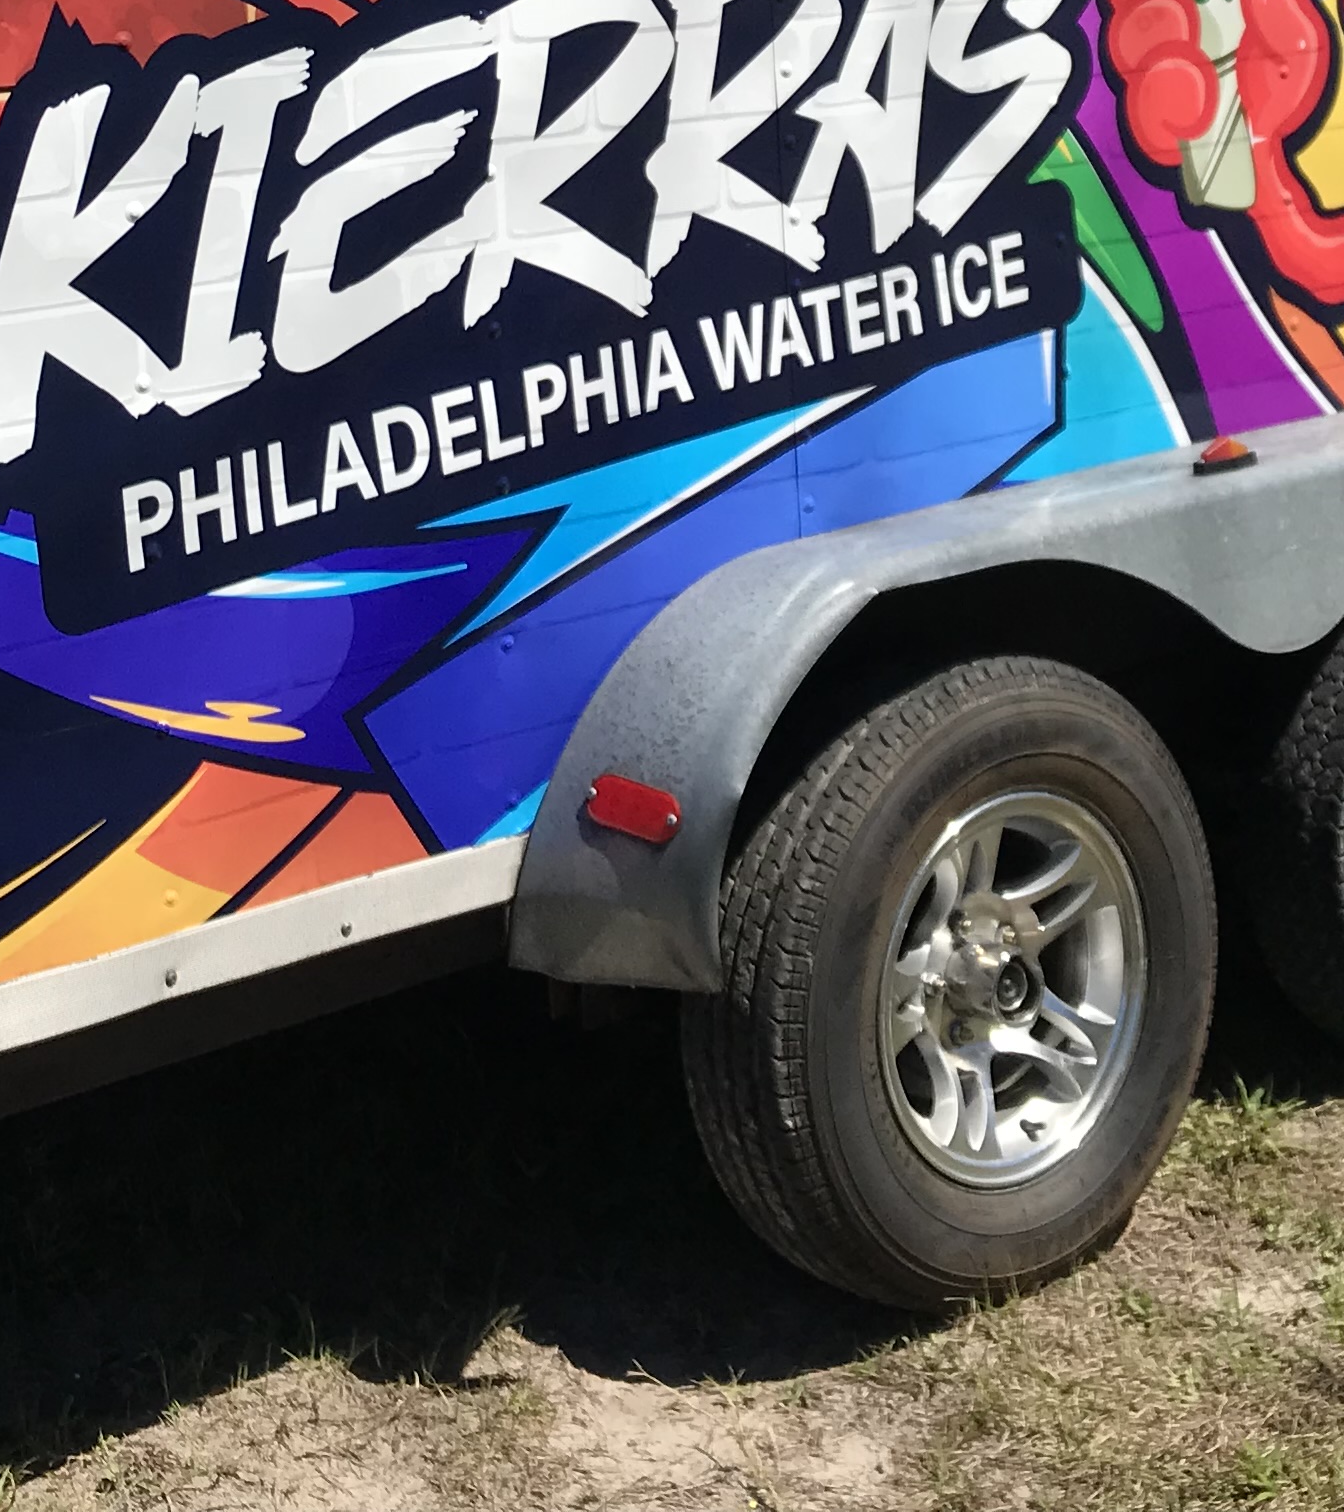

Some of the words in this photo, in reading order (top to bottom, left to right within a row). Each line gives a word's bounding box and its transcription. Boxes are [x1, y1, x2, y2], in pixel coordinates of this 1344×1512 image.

[119, 330, 694, 574] PHILADELPHIA
[696, 269, 922, 391] WATER
[932, 230, 1031, 329] ICE
